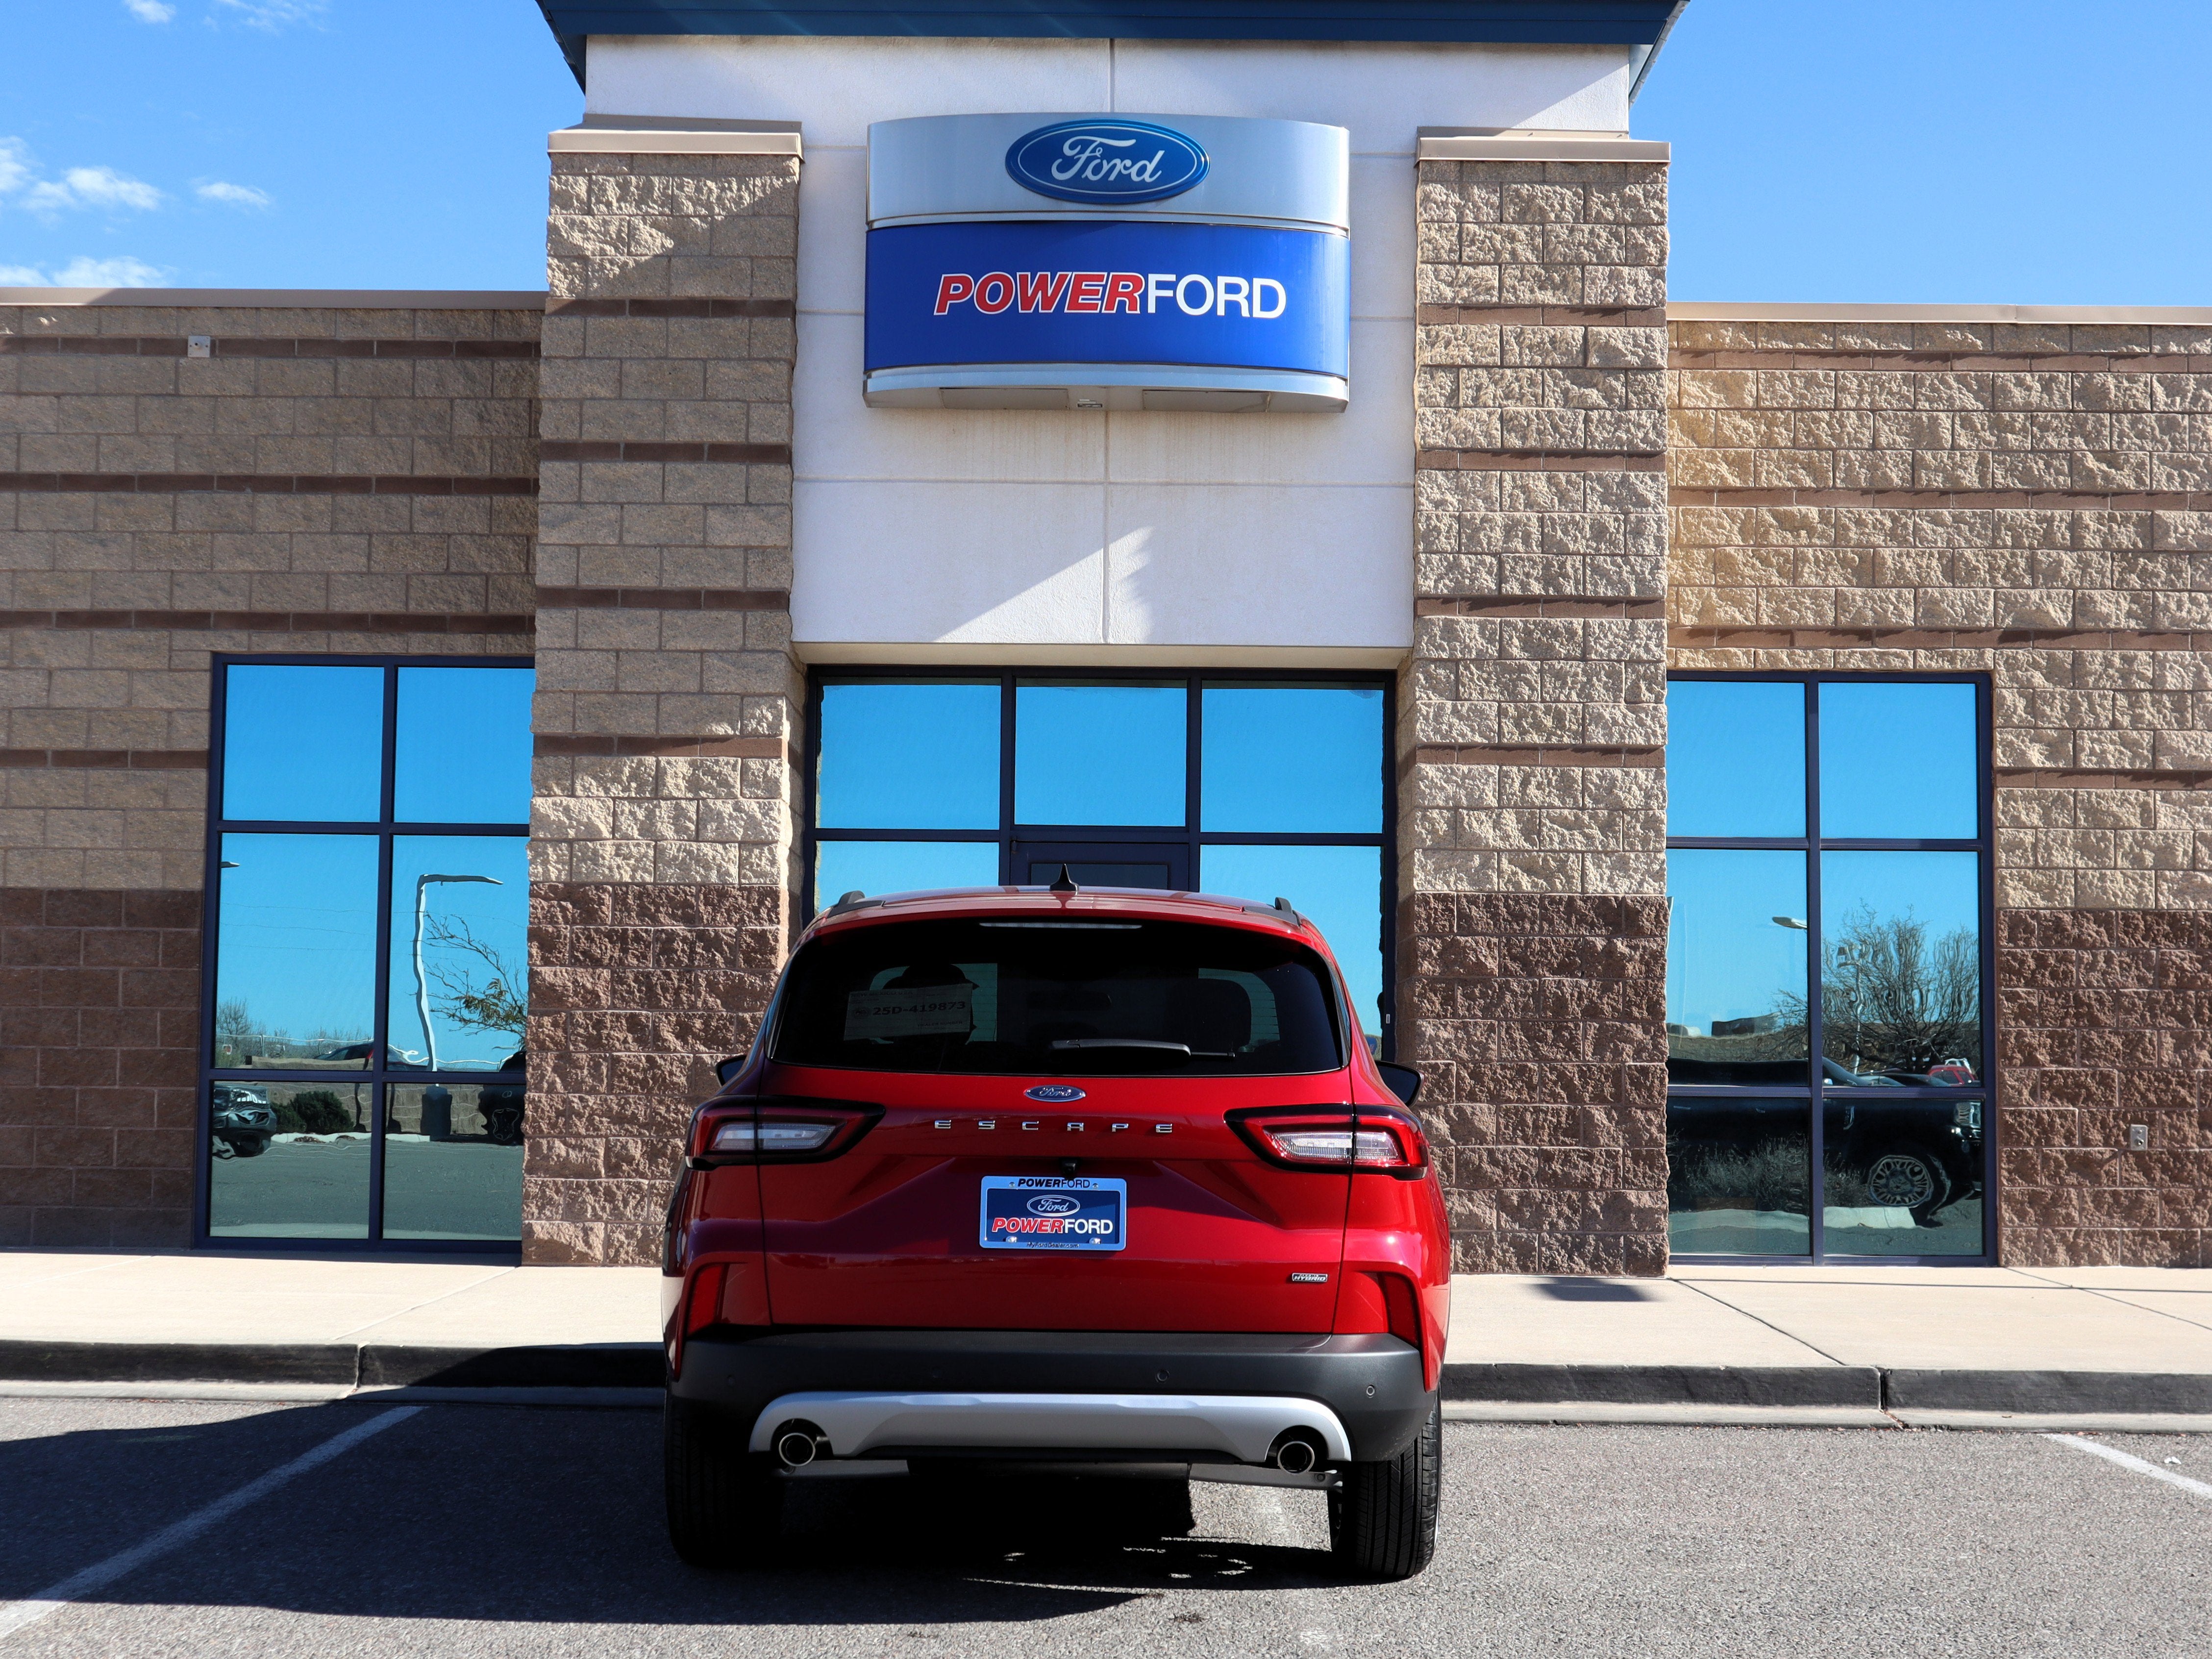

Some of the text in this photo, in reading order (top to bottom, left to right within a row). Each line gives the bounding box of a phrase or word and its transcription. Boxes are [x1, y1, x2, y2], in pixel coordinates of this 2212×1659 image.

[1051, 135, 1164, 183] Ford
[933, 271, 1287, 319] POWERFORD
[872, 1001, 966, 1015] 25D-419873
[934, 1119, 1172, 1133] ESCAPE
[1018, 1178, 1091, 1189] POWERFORD
[1037, 1198, 1069, 1212] Ford
[991, 1217, 1113, 1235] POWERFORD
